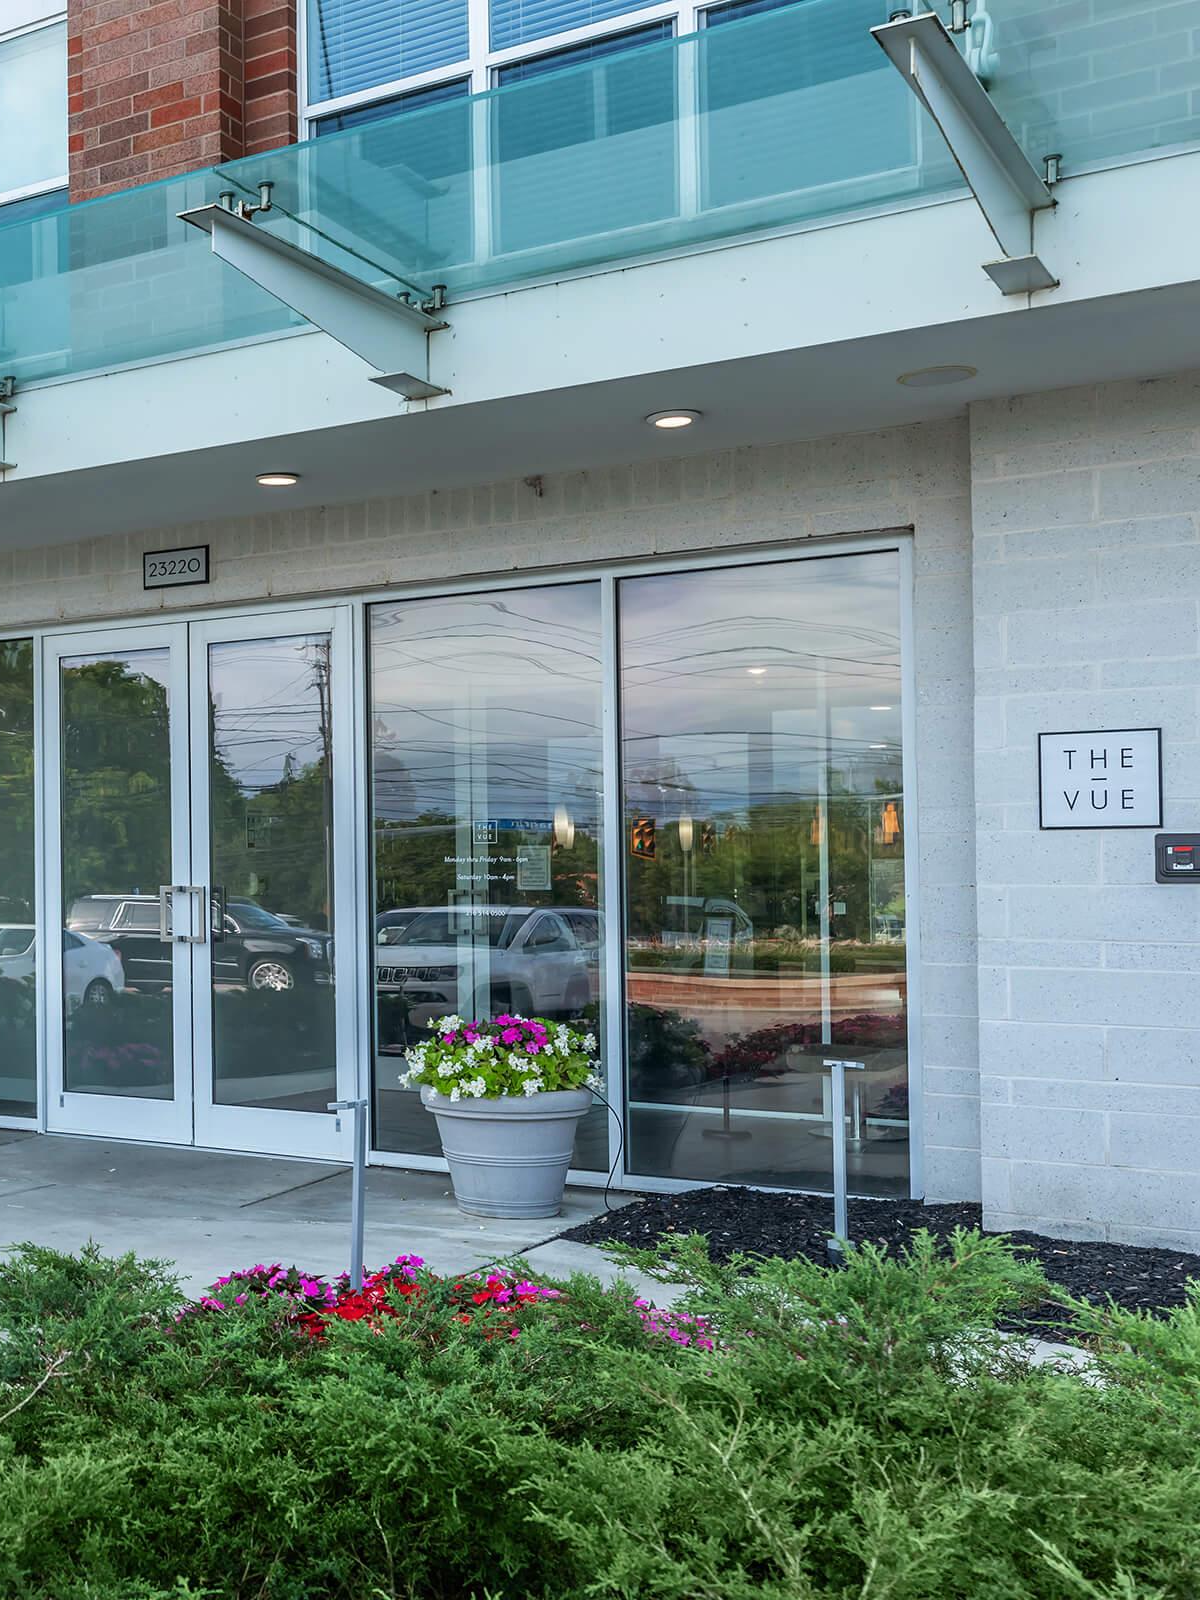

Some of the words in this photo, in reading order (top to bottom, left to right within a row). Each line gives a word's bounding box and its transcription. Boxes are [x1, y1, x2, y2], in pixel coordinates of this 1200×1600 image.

[148, 557, 201, 577] 23220
[1062, 747, 1134, 770] THE
[1063, 788, 1135, 812] VUE
[477, 823, 493, 831] THE
[444, 856, 466, 864] Monday
[479, 856, 498, 864] Friday
[515, 856, 529, 864] 6pm
[456, 873, 481, 881] Saturday
[502, 873, 515, 881] 4pm
